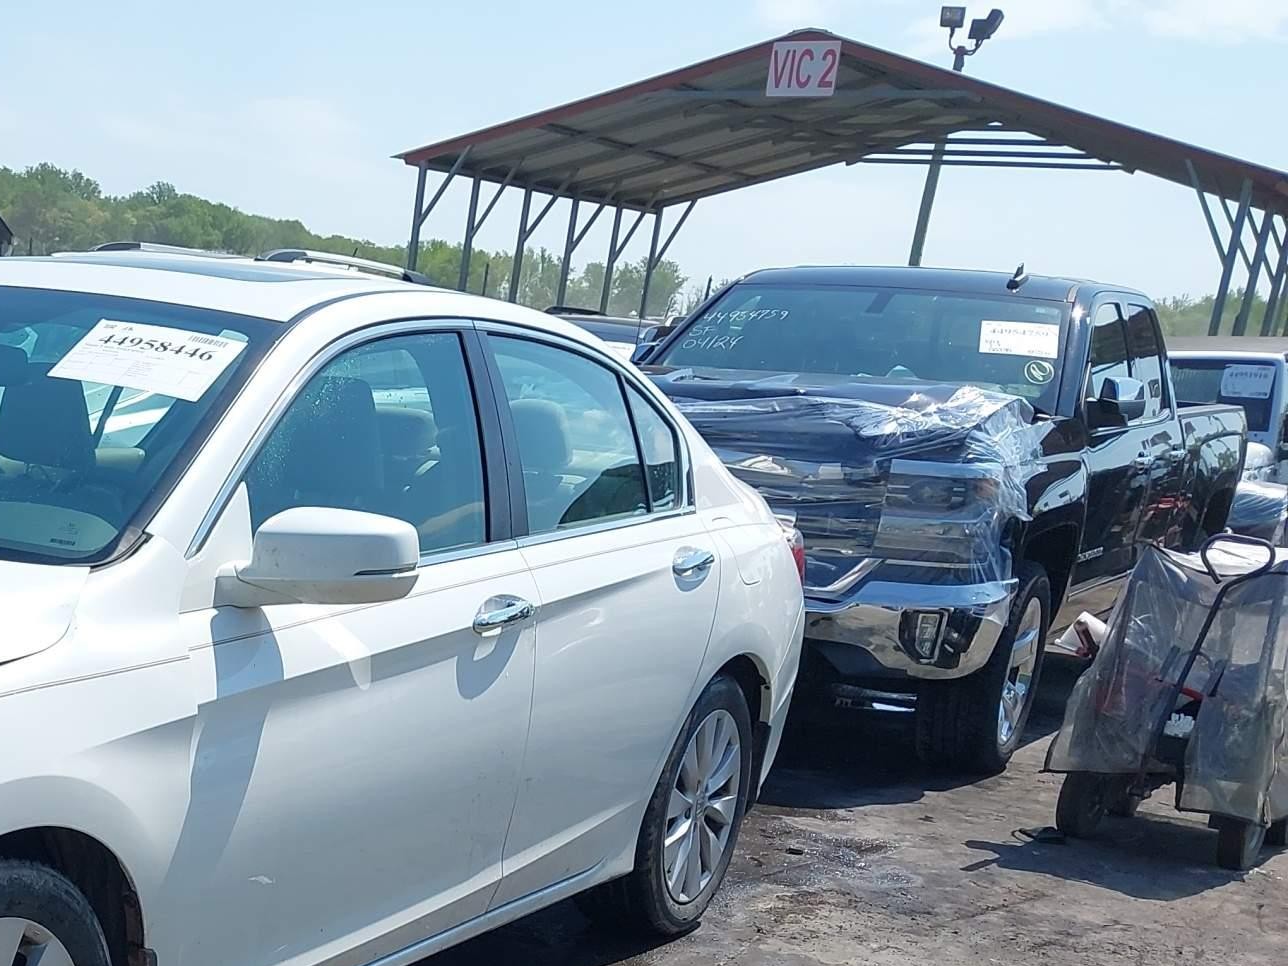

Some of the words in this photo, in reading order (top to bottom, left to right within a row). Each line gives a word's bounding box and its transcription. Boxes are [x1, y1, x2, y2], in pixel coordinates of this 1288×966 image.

[774, 48, 814, 88] VIC
[817, 48, 837, 88] 2
[703, 308, 790, 325] 44954759
[98, 333, 216, 361] 44958446
